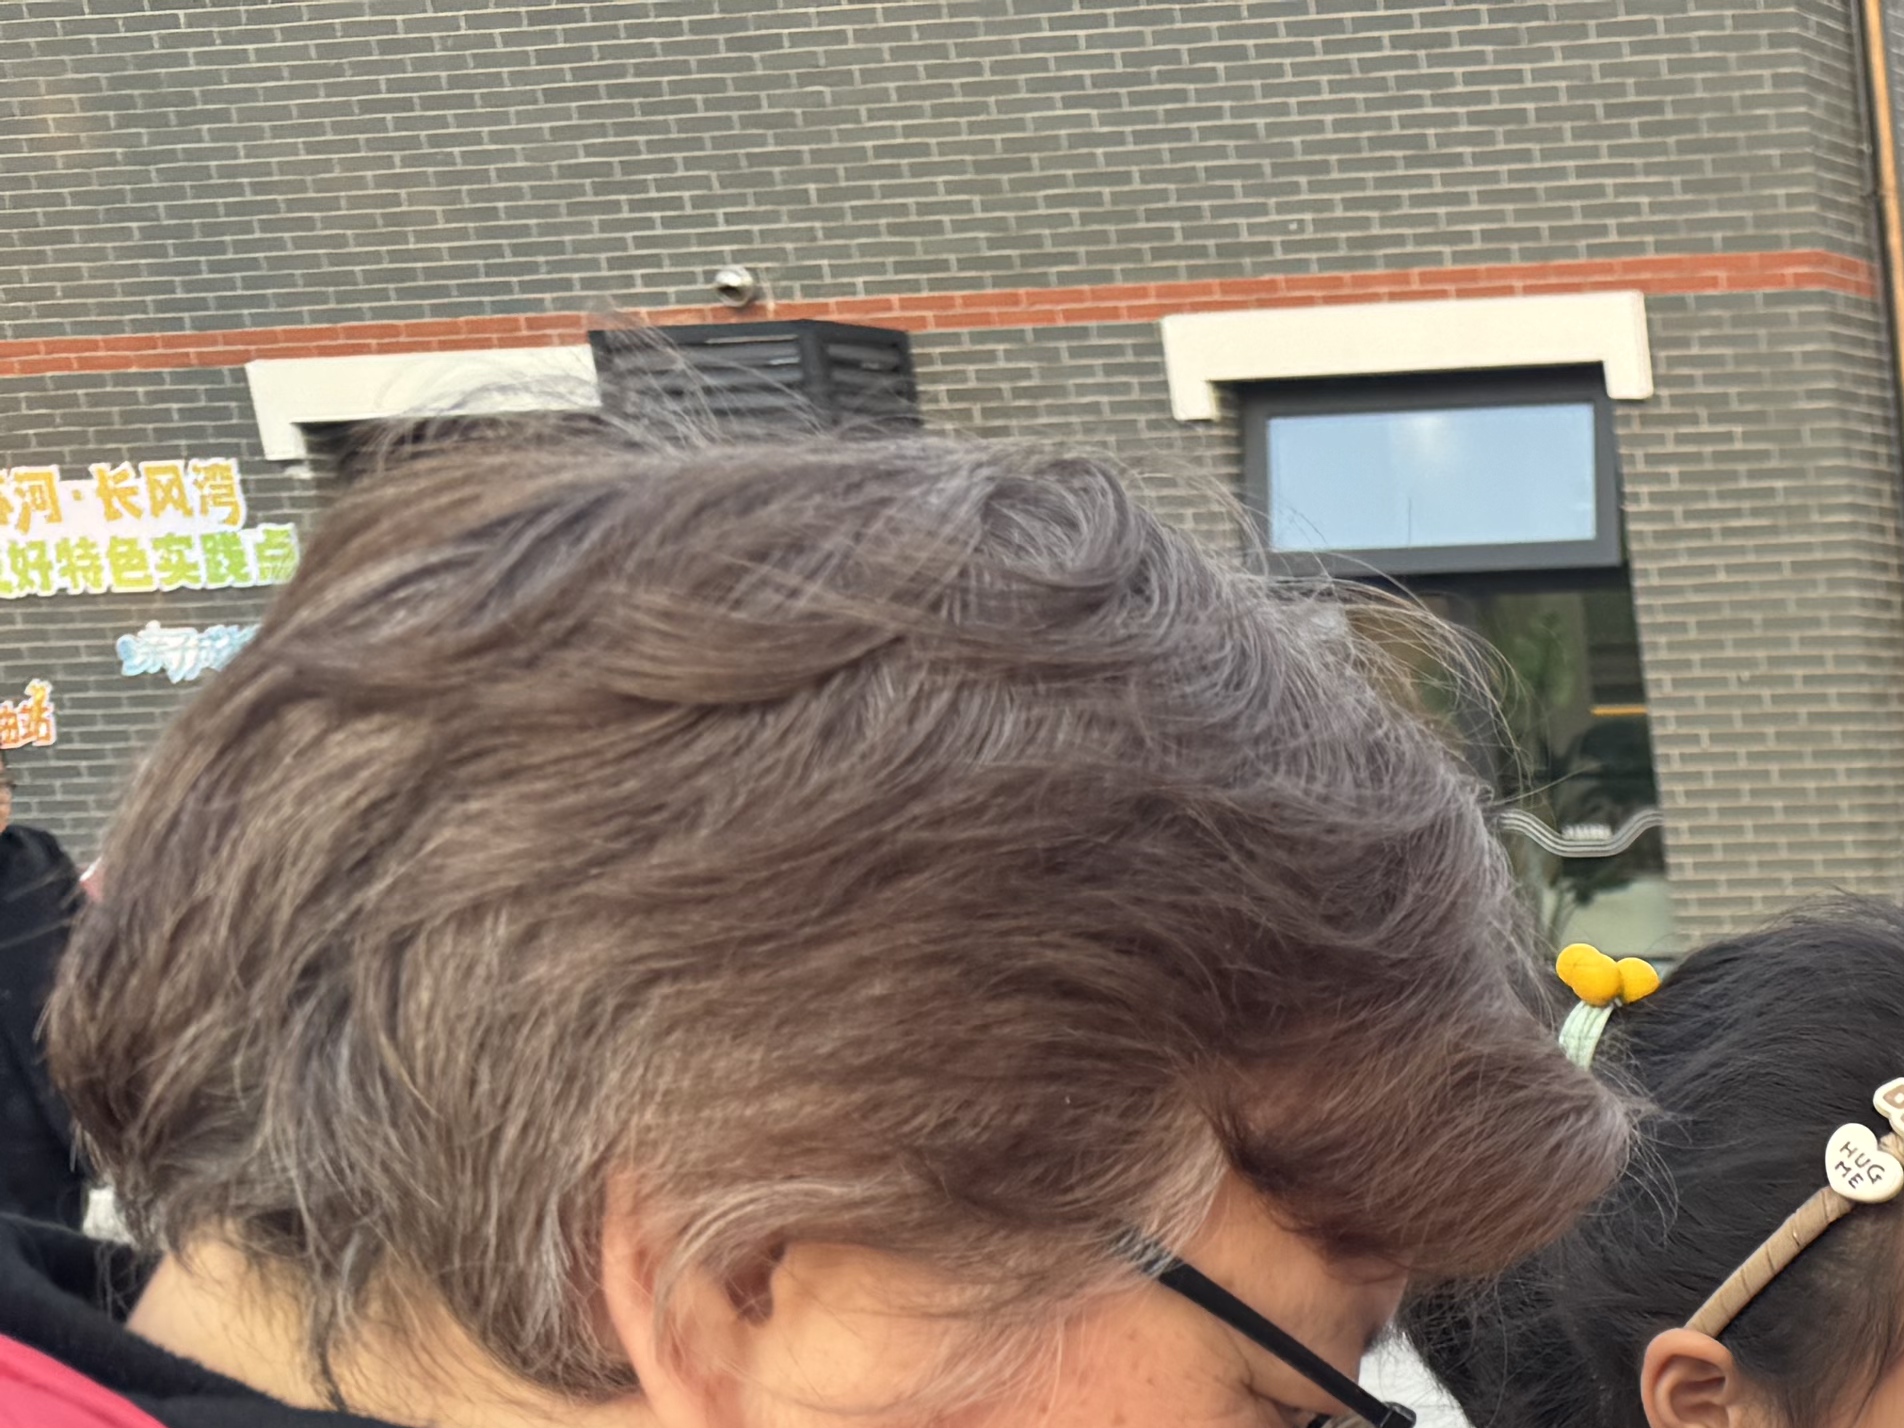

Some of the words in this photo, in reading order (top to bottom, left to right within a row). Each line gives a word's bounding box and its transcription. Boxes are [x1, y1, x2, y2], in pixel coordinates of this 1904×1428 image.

[0, 464, 243, 534] 河·长风湾
[0, 527, 294, 594] 好特色实践点
[1835, 1161, 1864, 1189] ME
[1840, 1141, 1885, 1184] HUG
